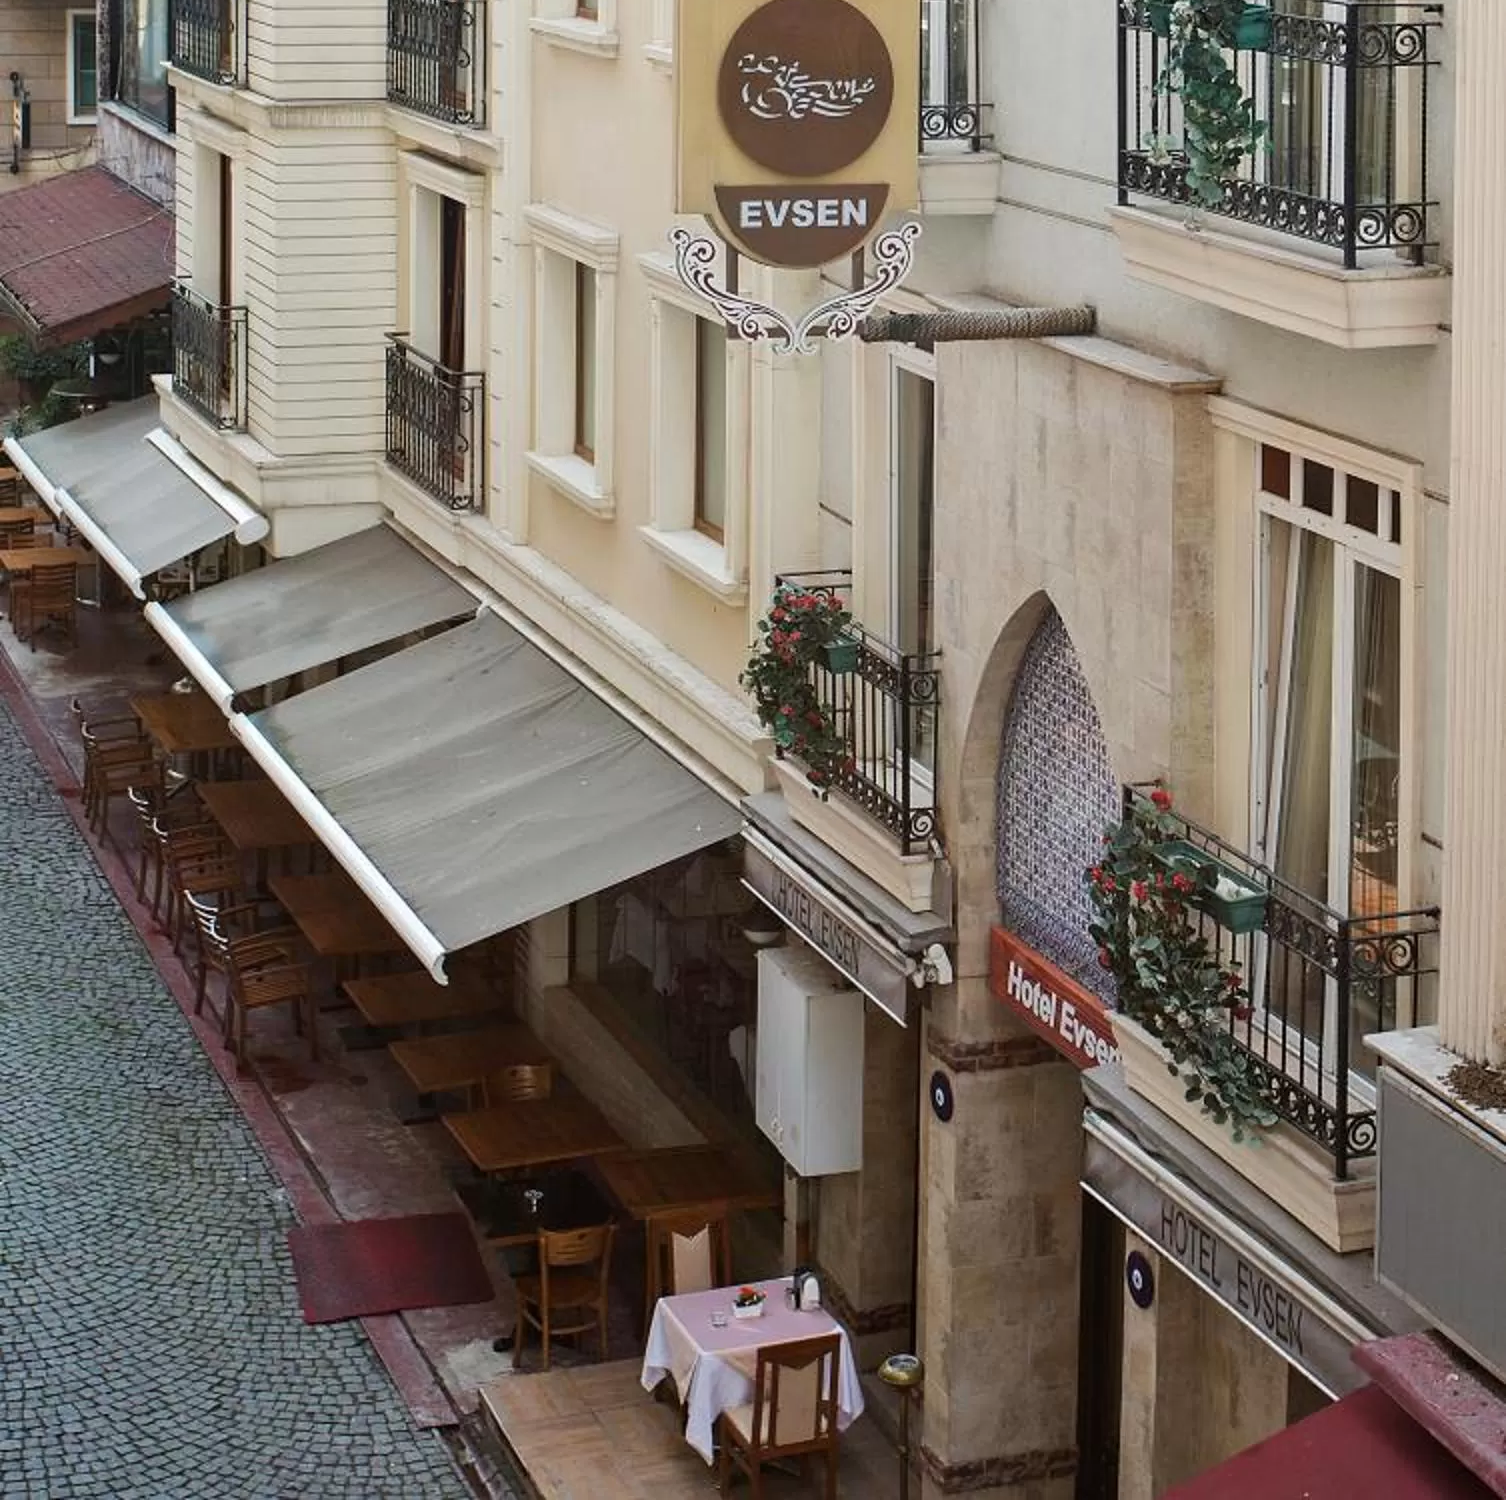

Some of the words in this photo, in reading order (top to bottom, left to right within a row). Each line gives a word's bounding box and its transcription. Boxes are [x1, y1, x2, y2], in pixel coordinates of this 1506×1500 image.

[739, 199, 868, 229] EVSEN
[821, 910, 859, 976] EVSEN
[1007, 960, 1057, 1028] Hotel
[1160, 1200, 1222, 1288] HOTEL
[1236, 1257, 1304, 1355] EVSEN
